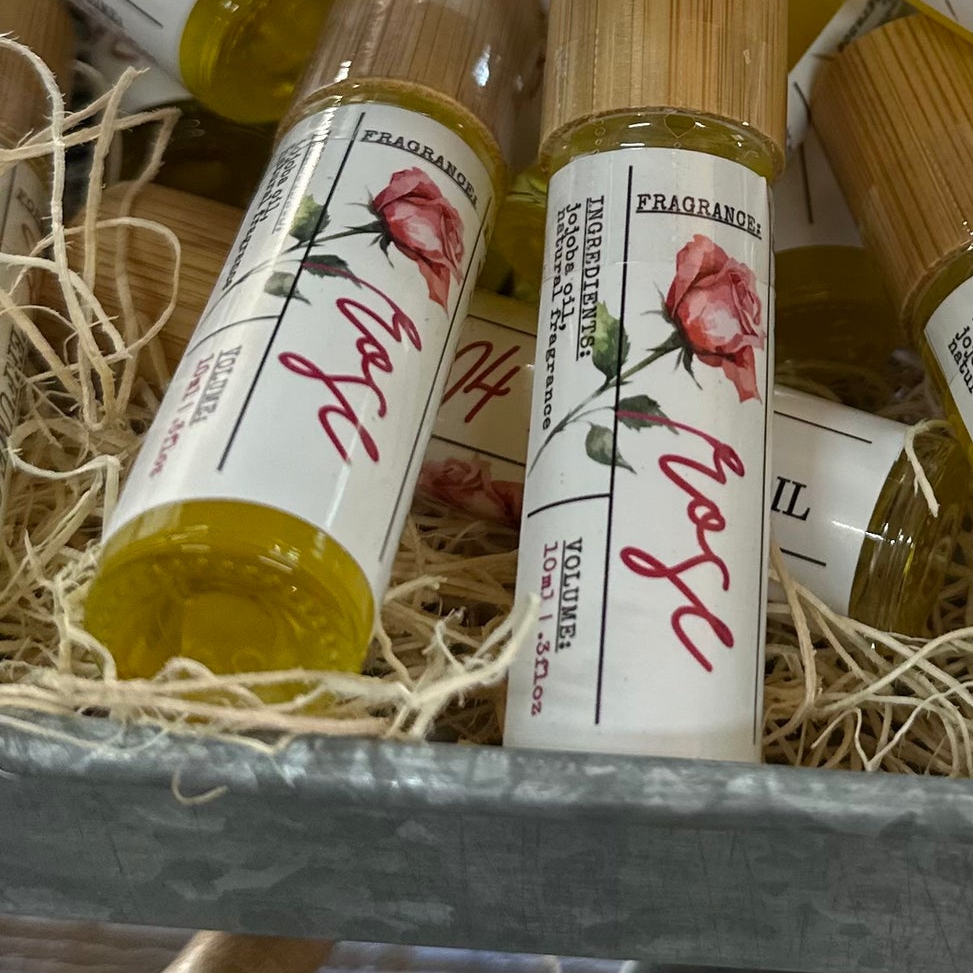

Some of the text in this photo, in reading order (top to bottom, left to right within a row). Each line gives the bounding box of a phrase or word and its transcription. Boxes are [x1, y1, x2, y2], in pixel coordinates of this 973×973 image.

[359, 129, 478, 209] FRAGRANCE:
[636, 193, 763, 240] FRAGRANCE:
[557, 202, 582, 332] jojoba oil,
[576, 195, 605, 362] INGREDIENTS:
[542, 209, 566, 432] natural fragrance
[770, 475, 811, 522] IL
[539, 540, 559, 603] 10ml
[555, 537, 584, 653] VOLUME:
[530, 630, 552, 717] .3floz
